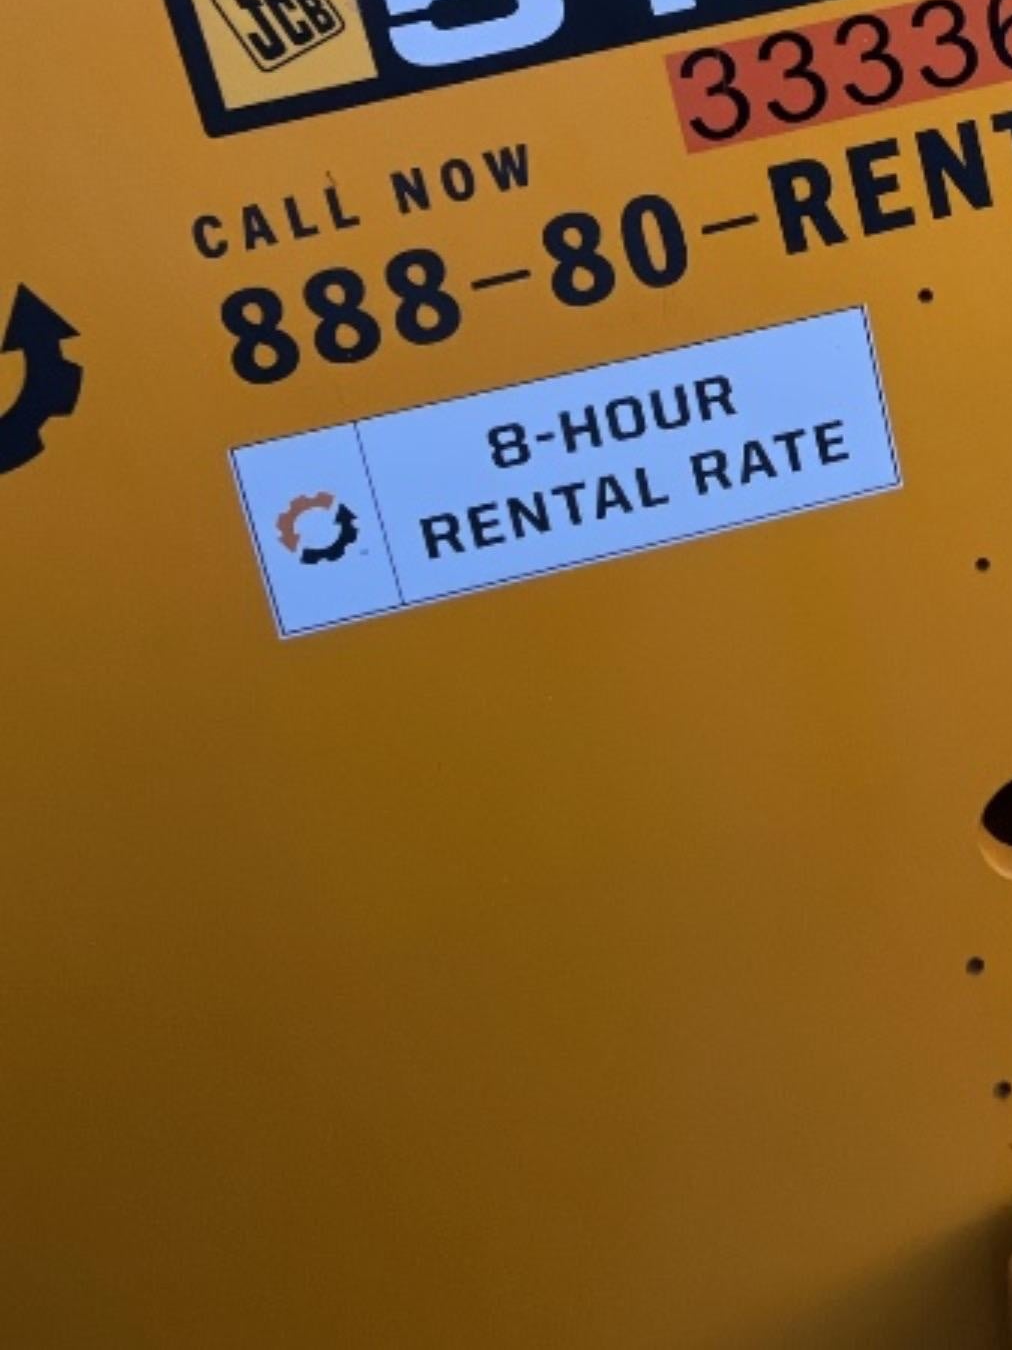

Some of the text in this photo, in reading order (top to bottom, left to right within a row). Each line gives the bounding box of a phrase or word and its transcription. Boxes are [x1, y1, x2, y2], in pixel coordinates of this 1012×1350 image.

[192, 143, 530, 259] CALL NOW
[486, 374, 738, 469] 8-HOUR
[419, 418, 851, 560] RENTAL RATE
